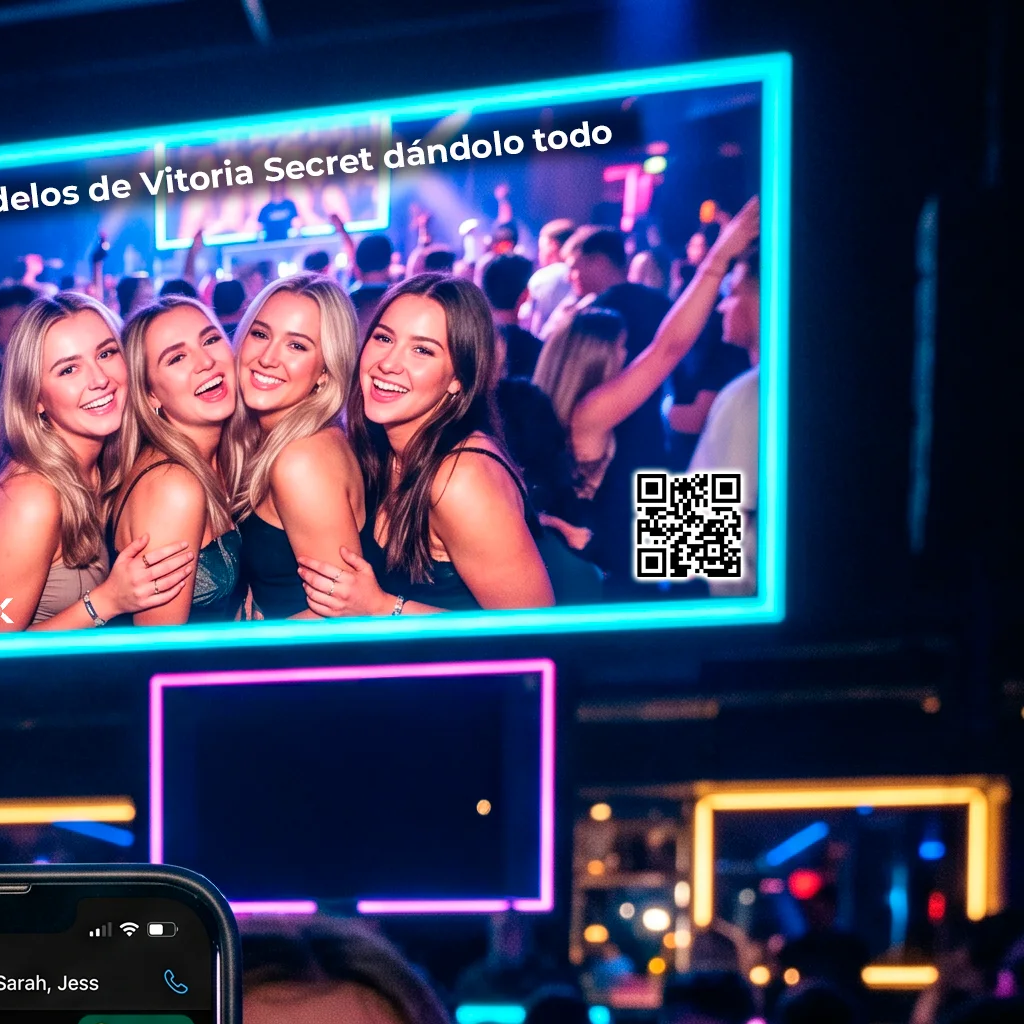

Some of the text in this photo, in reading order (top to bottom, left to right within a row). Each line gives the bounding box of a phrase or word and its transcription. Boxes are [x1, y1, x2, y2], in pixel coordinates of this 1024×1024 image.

[88, 175, 131, 202] de
[139, 159, 254, 195] Vitoria
[263, 148, 374, 182] Secret
[383, 131, 525, 169] dándolo
[532, 121, 613, 152] todo
[57, 975, 99, 991] Jess
